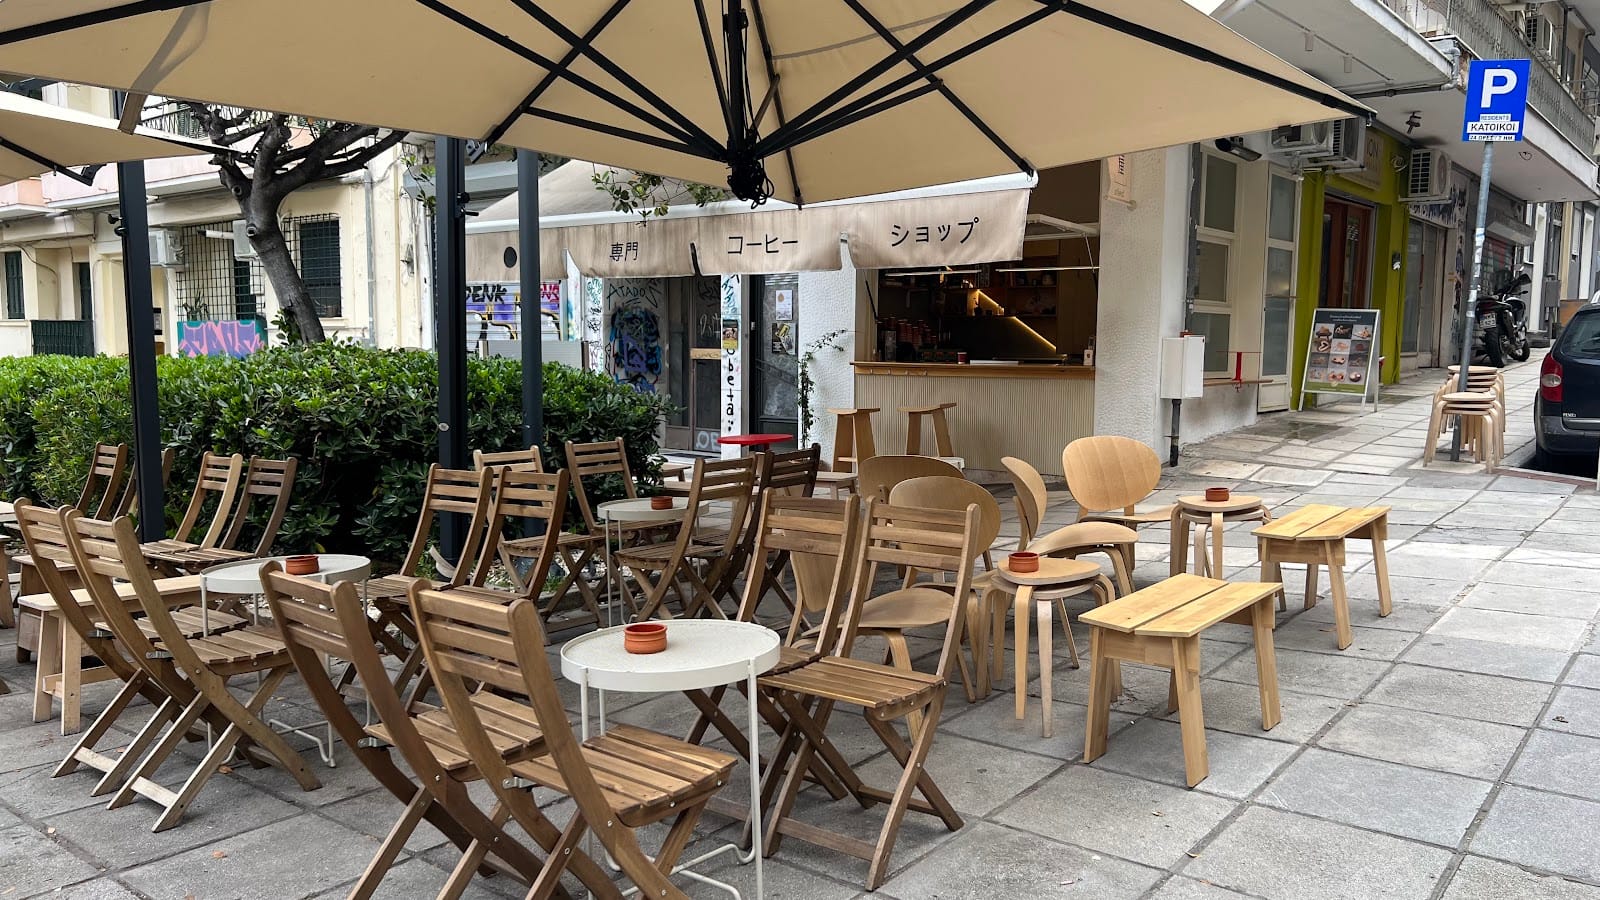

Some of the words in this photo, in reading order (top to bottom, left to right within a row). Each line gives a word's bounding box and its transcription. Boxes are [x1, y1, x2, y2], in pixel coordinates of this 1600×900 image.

[1481, 68, 1518, 108] P
[1470, 123, 1516, 132] ΚΑΤΟΙΚΟΙ
[609, 241, 639, 262] 専門
[727, 233, 799, 255] コーヒー
[891, 216, 980, 247] ショップ
